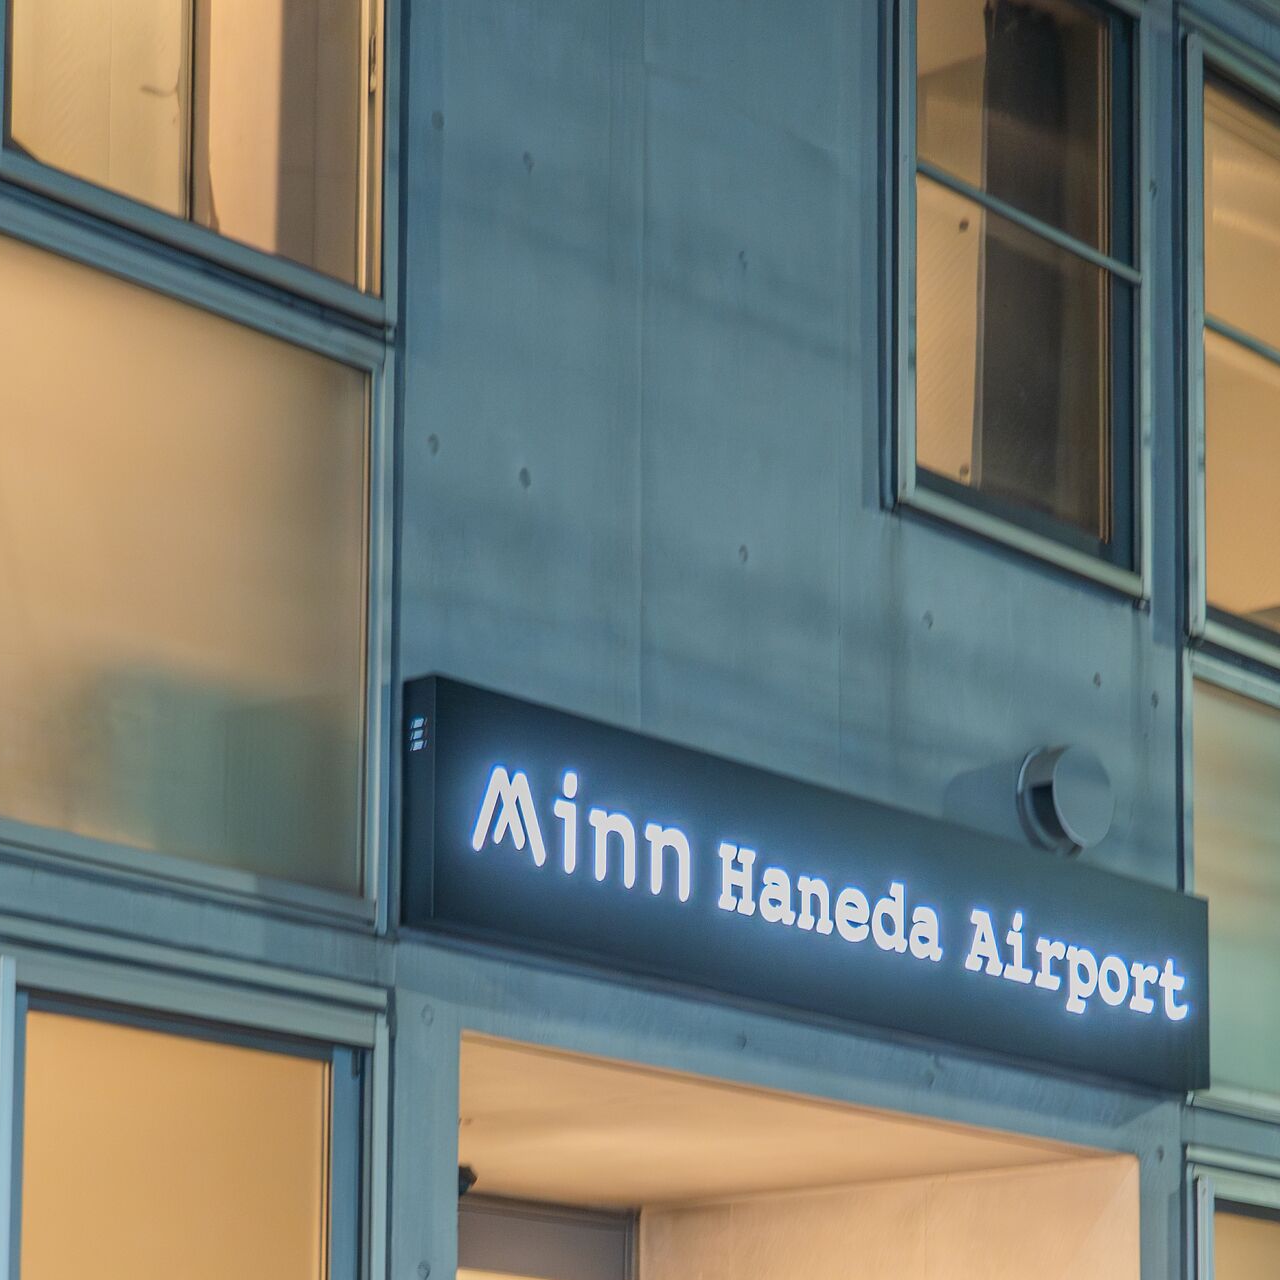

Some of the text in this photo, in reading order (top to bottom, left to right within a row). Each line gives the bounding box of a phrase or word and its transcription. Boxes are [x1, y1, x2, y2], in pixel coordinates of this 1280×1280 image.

[473, 766, 1188, 1021] Minn Haneda Airport
